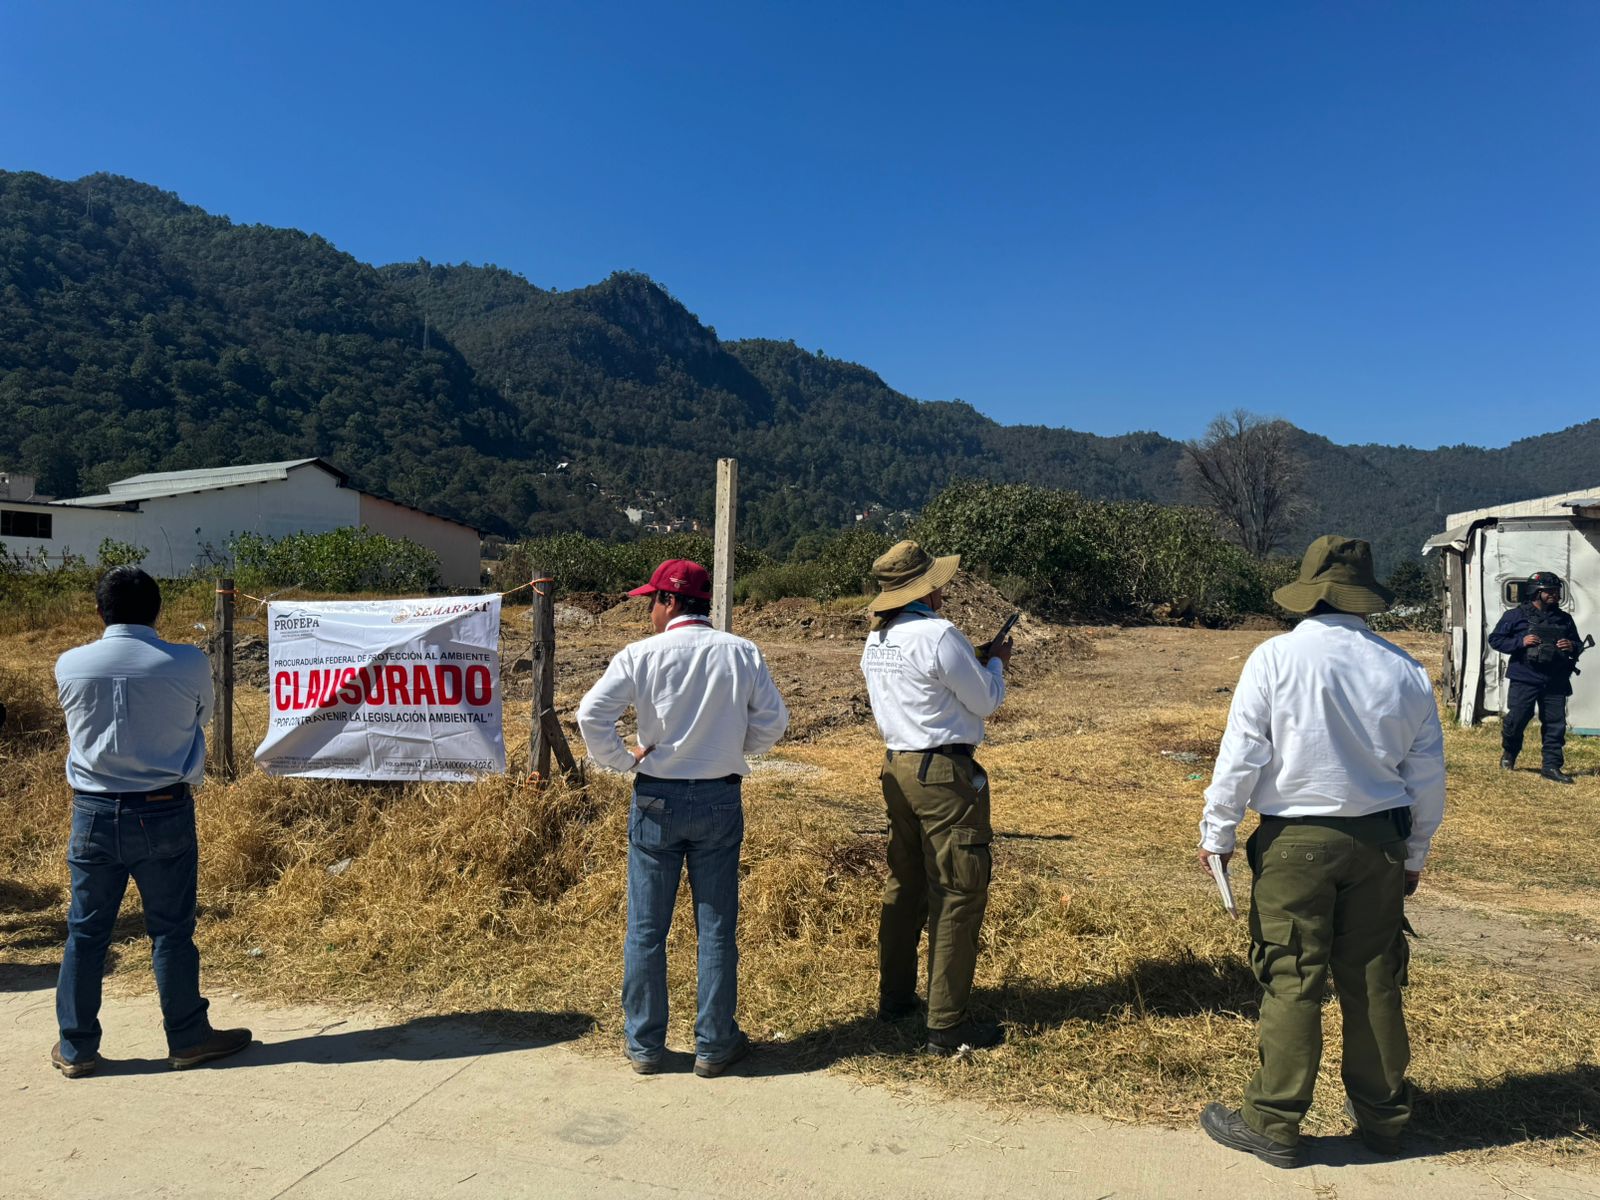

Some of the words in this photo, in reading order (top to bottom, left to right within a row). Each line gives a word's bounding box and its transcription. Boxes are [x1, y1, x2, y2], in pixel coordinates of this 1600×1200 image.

[413, 601, 490, 618] SEMARNAT
[274, 617, 320, 630] PROFEPA
[274, 656, 324, 667] PROCURADURÍA
[325, 655, 356, 664] FEDERAL
[357, 655, 367, 663] DE
[368, 651, 422, 662] PROTECCIÓN
[424, 652, 437, 660] AL
[440, 652, 490, 661] AMBIENTE
[866, 648, 902, 661] PROFEPA
[275, 664, 492, 711] CLAUSURADO
[289, 711, 347, 727] CONTRAVENIR
[350, 711, 361, 722] LA
[363, 711, 426, 722] LEGISLACIÓN
